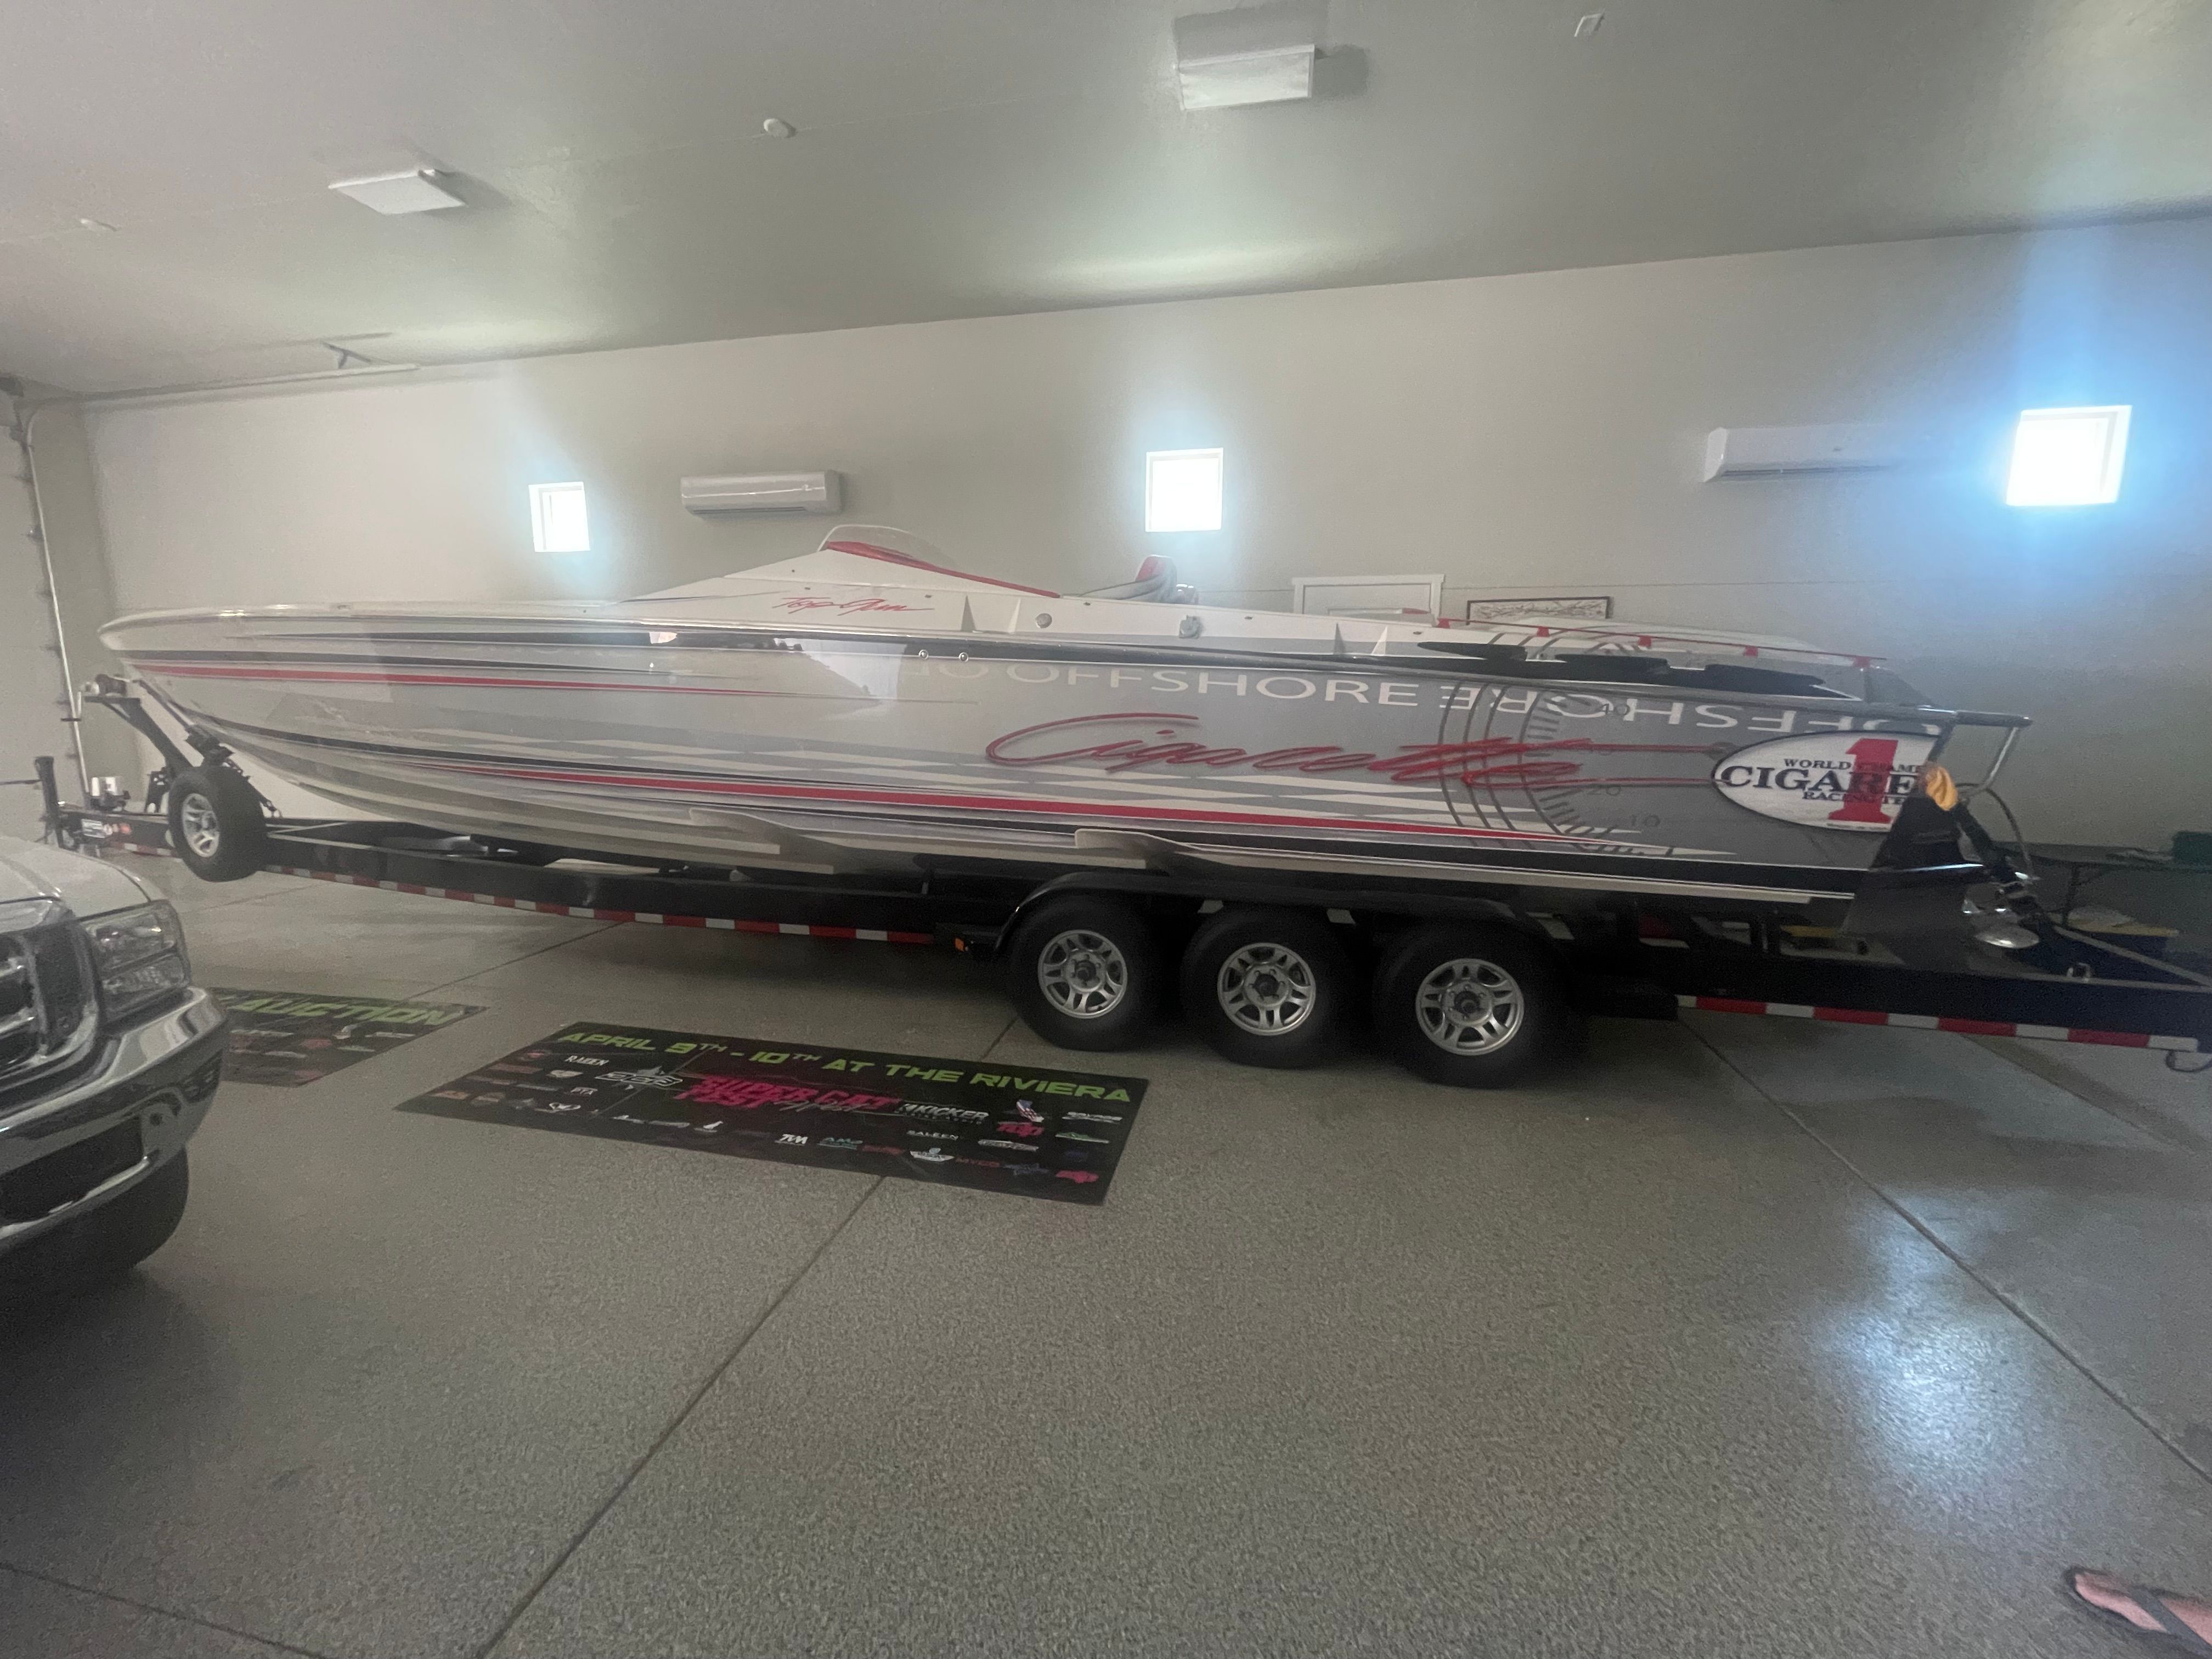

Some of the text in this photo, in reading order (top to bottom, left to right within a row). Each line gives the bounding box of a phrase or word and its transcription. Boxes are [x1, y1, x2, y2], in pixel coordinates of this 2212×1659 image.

[1006, 664, 1419, 707] OFFSHORE
[1783, 758, 1853, 770] WORLD
[1720, 765, 1918, 795] CIGARE
[558, 1032, 657, 1051] APRIL
[748, 1051, 822, 1064] 10TH
[821, 1058, 876, 1073] AT
[885, 1064, 964, 1084] THE
[970, 1073, 1131, 1103] RIVIERA
[913, 1104, 990, 1121] KICKER
